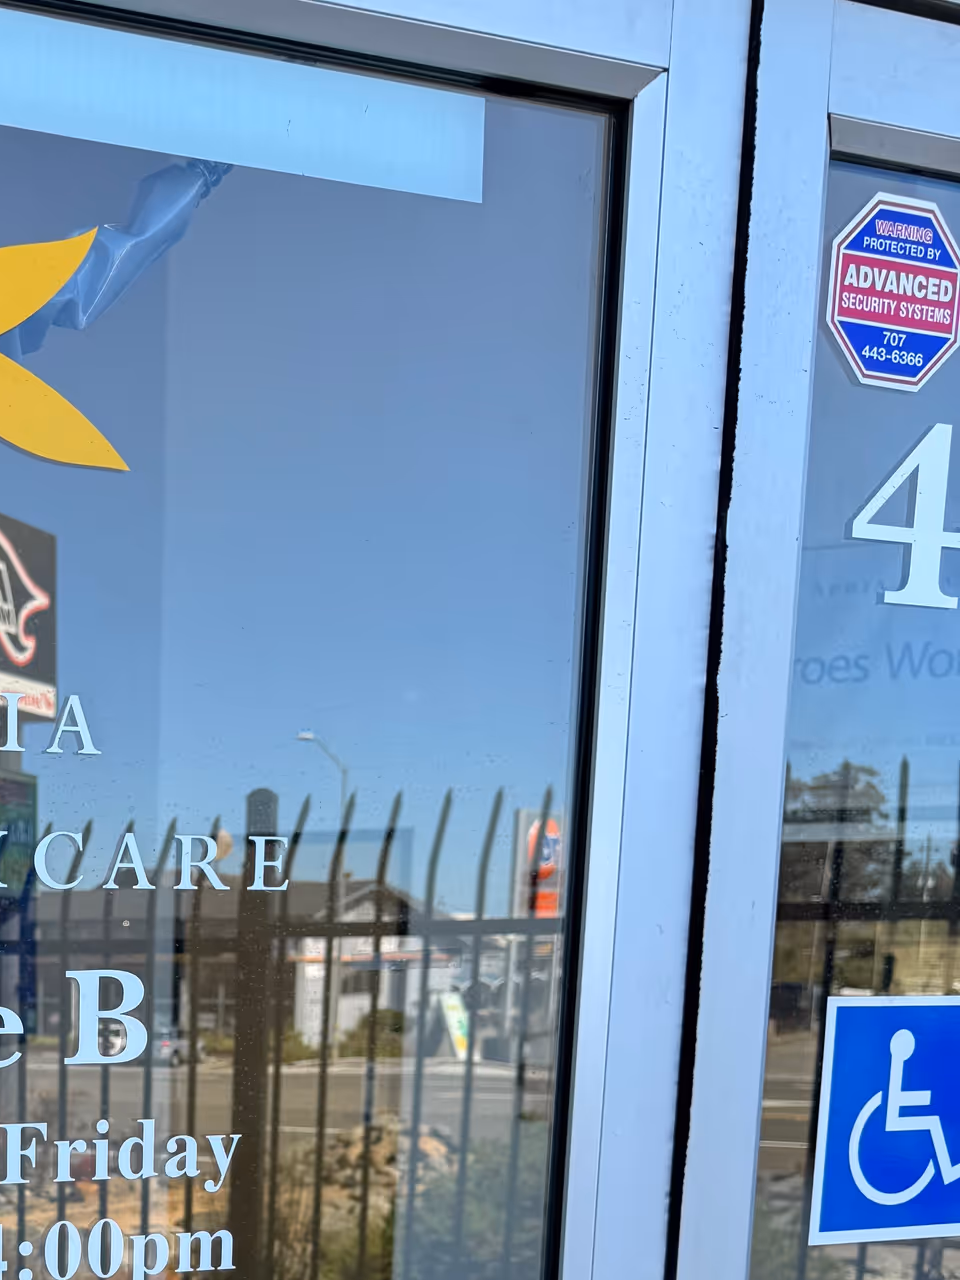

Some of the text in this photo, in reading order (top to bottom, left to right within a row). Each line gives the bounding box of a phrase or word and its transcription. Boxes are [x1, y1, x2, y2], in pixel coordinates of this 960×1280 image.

[863, 236, 942, 261] PROTECTED BY
[875, 220, 933, 244] WARNING
[844, 264, 953, 303] ADVANCED
[841, 292, 952, 325] SECURITY SYSTEMS
[862, 345, 924, 367] 443-6366
[882, 331, 906, 348] 707
[851, 422, 960, 609] 4
[886, 641, 960, 680] Wo
[63, 969, 147, 1065] B
